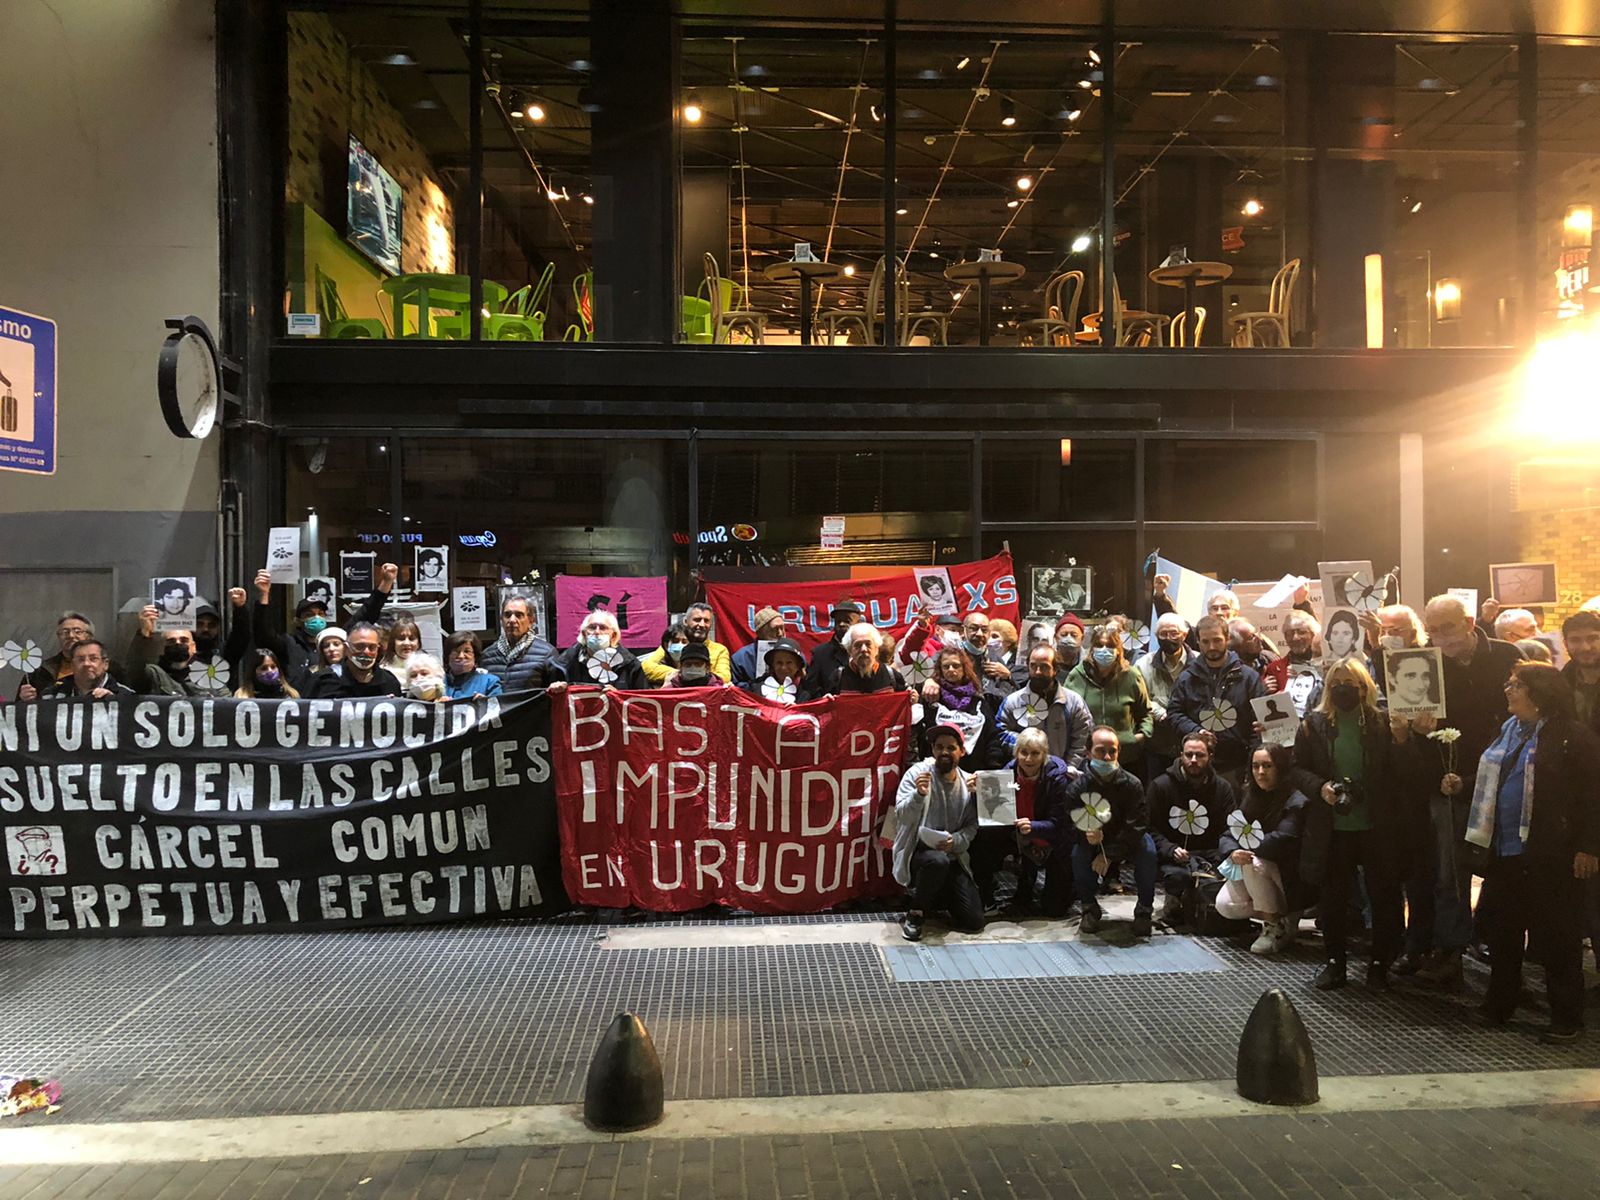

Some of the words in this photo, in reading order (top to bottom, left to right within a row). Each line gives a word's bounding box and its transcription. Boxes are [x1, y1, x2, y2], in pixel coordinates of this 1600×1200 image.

[0, 704, 39, 752] NI
[55, 701, 119, 751] UN
[133, 701, 261, 748] SOLO
[568, 691, 820, 765] BASTA
[850, 724, 905, 756] DE
[0, 762, 184, 812] SUELTO
[196, 763, 255, 811] EN
[269, 762, 356, 811] LAS
[371, 736, 551, 802] CALLES
[95, 816, 279, 870] CÁRCEL
[330, 804, 491, 863] COMUN
[8, 880, 268, 932] PERPETUA
[279, 879, 301, 923] Y
[319, 864, 545, 921] EFECTIVA
[580, 853, 625, 889] EN
